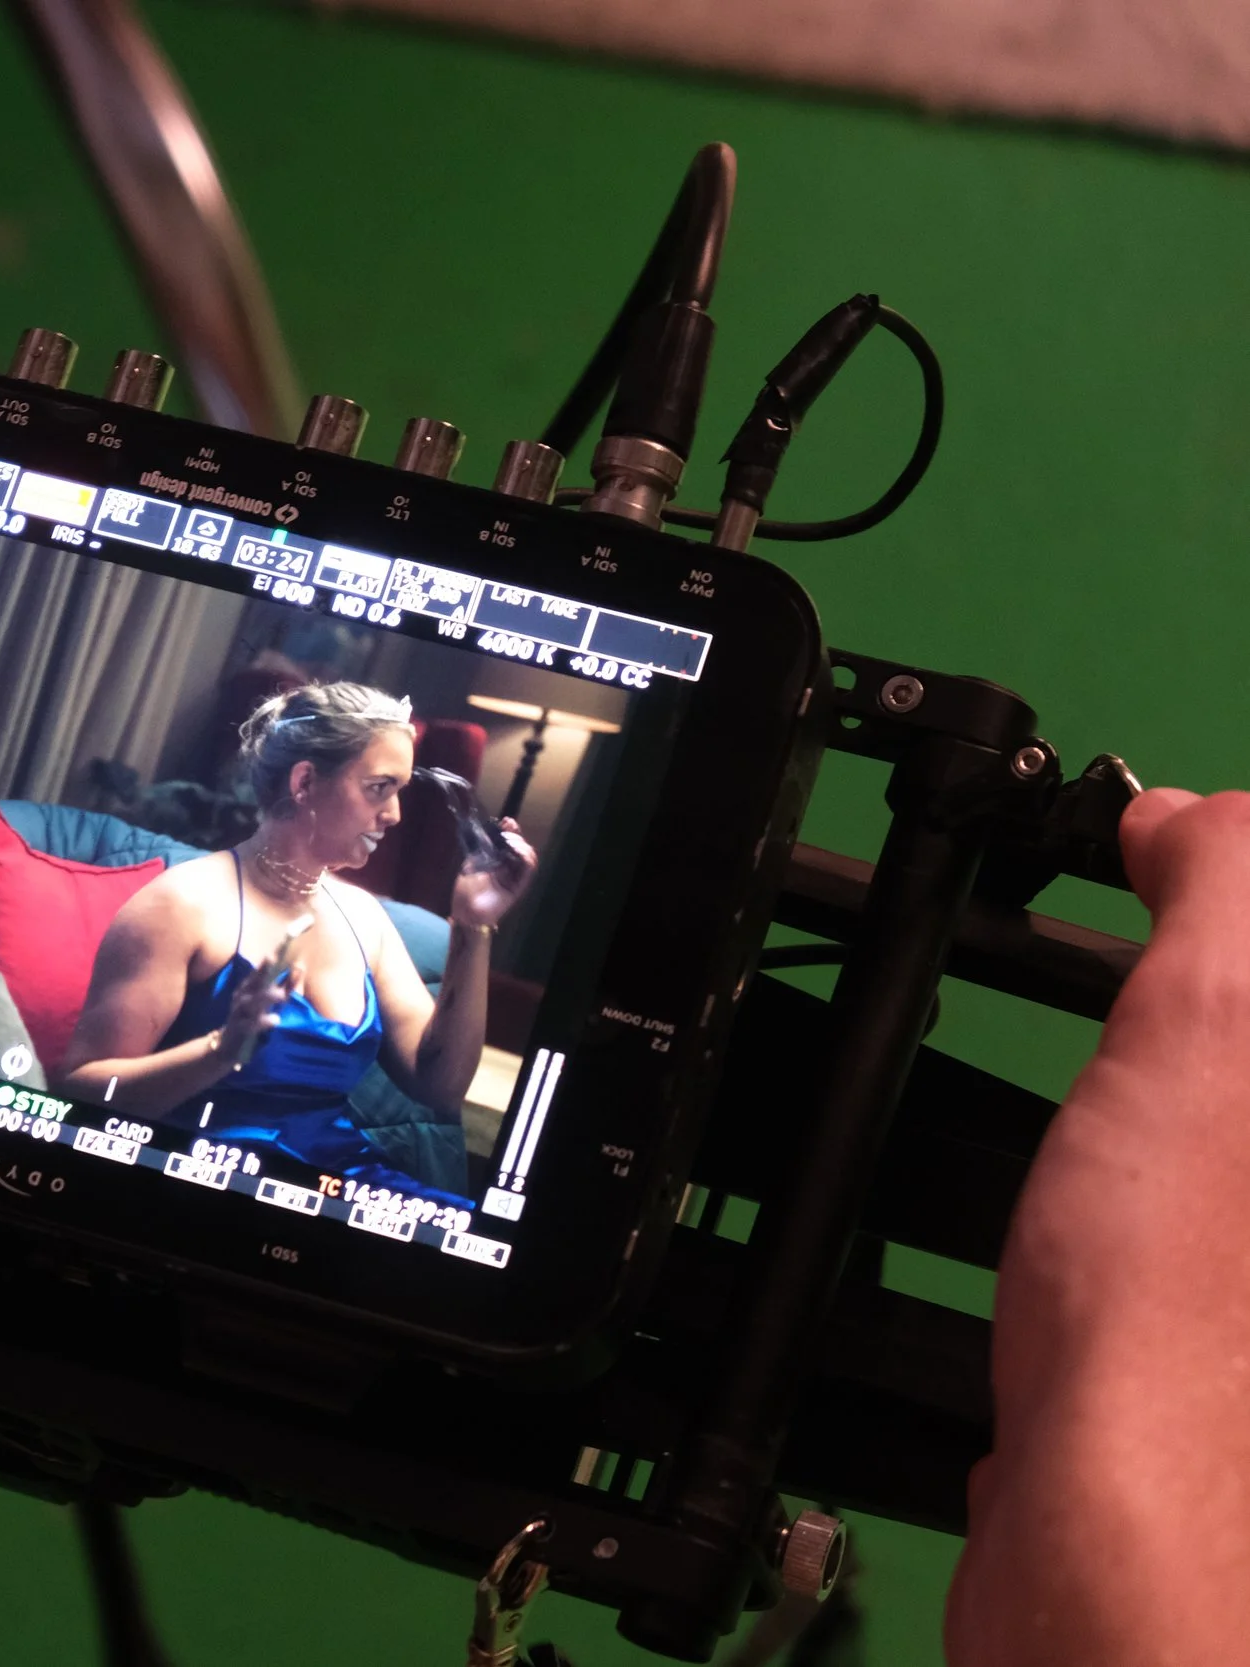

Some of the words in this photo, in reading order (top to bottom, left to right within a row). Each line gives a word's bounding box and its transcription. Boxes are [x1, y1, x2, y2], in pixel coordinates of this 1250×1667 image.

[0, 399, 30, 413] OUT
[6, 412, 28, 426] SDI
[86, 432, 97, 443] B
[98, 435, 122, 449] SDI
[198, 447, 214, 459] IN
[185, 457, 220, 473] HDMI
[139, 470, 188, 497] design
[281, 480, 292, 491] A
[294, 484, 317, 498] SDI
[188, 484, 271, 516] convergent
[99, 502, 142, 527] FULL
[385, 506, 410, 521] LTC
[493, 520, 509, 532] IN
[51, 524, 85, 545] IRIS
[479, 530, 490, 541] B
[491, 533, 515, 548] SDI
[239, 541, 304, 574] 03:24
[594, 546, 611, 558] IN
[581, 555, 592, 566] A
[593, 559, 617, 573] SDI
[334, 568, 381, 596] PLAY
[689, 569, 713, 583] ON
[252, 573, 272, 591] EI
[271, 579, 315, 605] 800
[680, 580, 714, 598] PWR
[490, 583, 534, 607] LAST
[541, 595, 582, 620] TAKE
[331, 593, 366, 618] ND
[367, 602, 404, 627] 0.6
[437, 616, 468, 639] WB
[477, 627, 536, 659] 4000
[535, 641, 558, 666] K
[569, 650, 619, 680] +0.0
[620, 662, 653, 689] CC
[602, 1007, 641, 1025] DOWN
[643, 1019, 674, 1035] SHUT
[651, 1037, 670, 1052] F2
[12, 1091, 72, 1123] STBY
[102, 1117, 153, 1144] CARD
[189, 1138, 241, 1170] 0:12
[242, 1152, 260, 1176] h
[602, 1144, 634, 1160] LOCK
[317, 1176, 341, 1196] TC
[497, 1170, 509, 1187] 1
[271, 1246, 298, 1263] SSD
